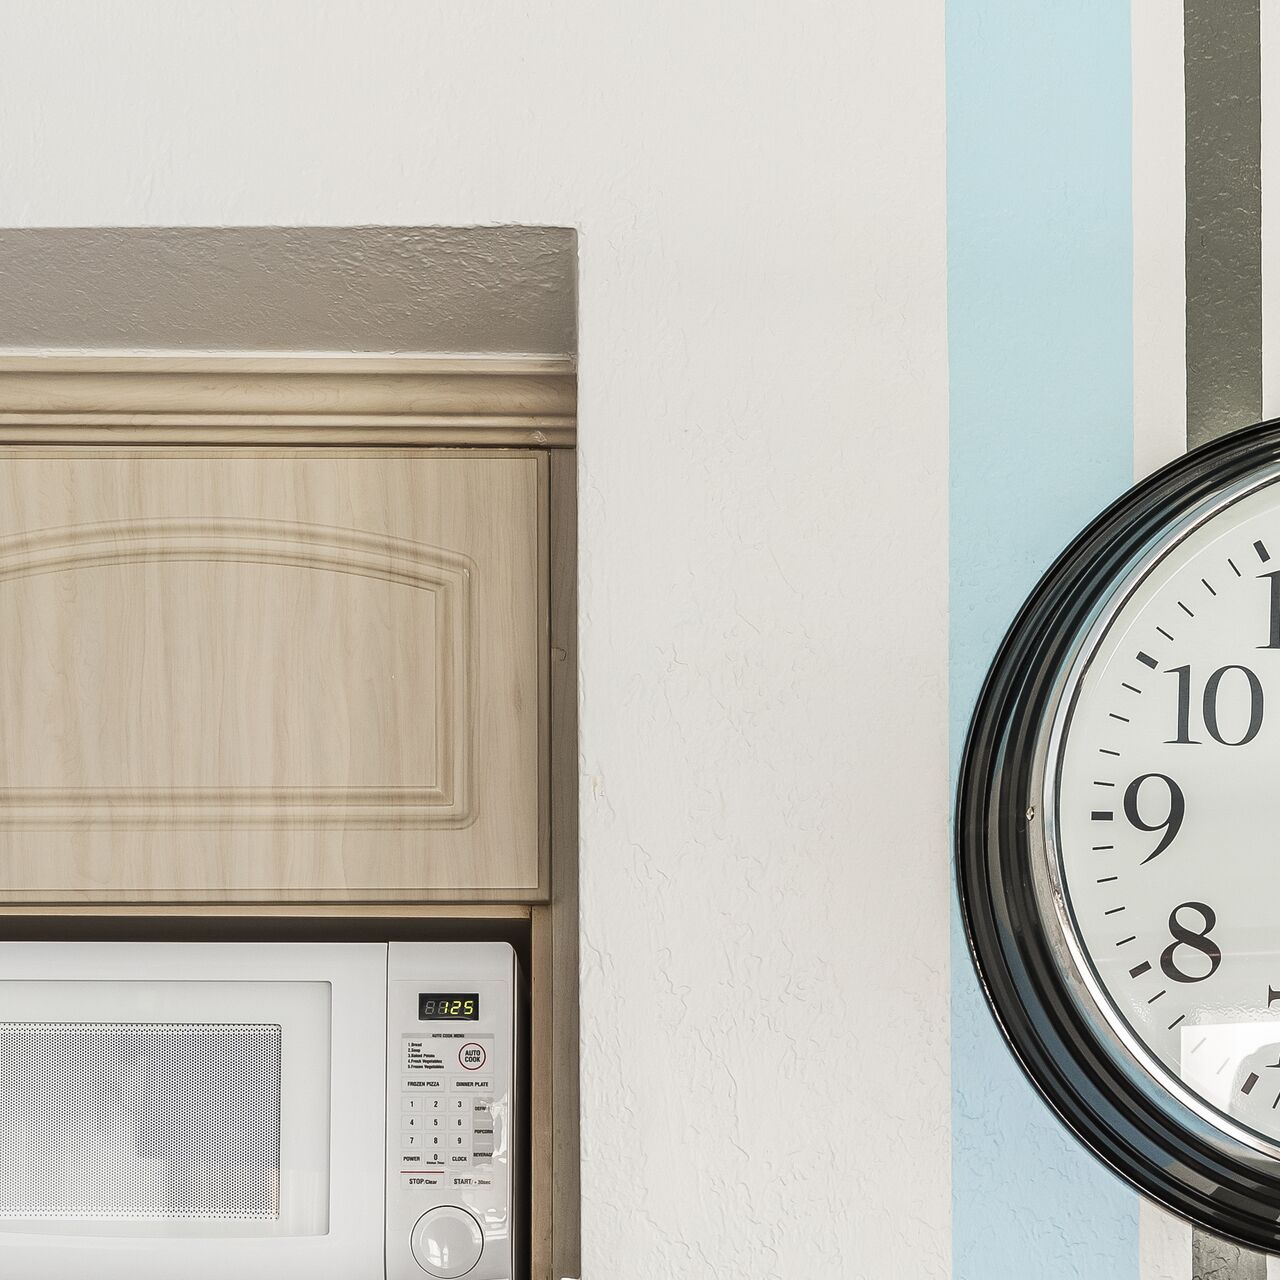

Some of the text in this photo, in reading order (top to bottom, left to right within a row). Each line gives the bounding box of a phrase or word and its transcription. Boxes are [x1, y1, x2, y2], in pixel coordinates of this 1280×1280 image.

[1163, 663, 1265, 748] 10
[1122, 773, 1185, 866] 9
[1160, 901, 1221, 983] 8
